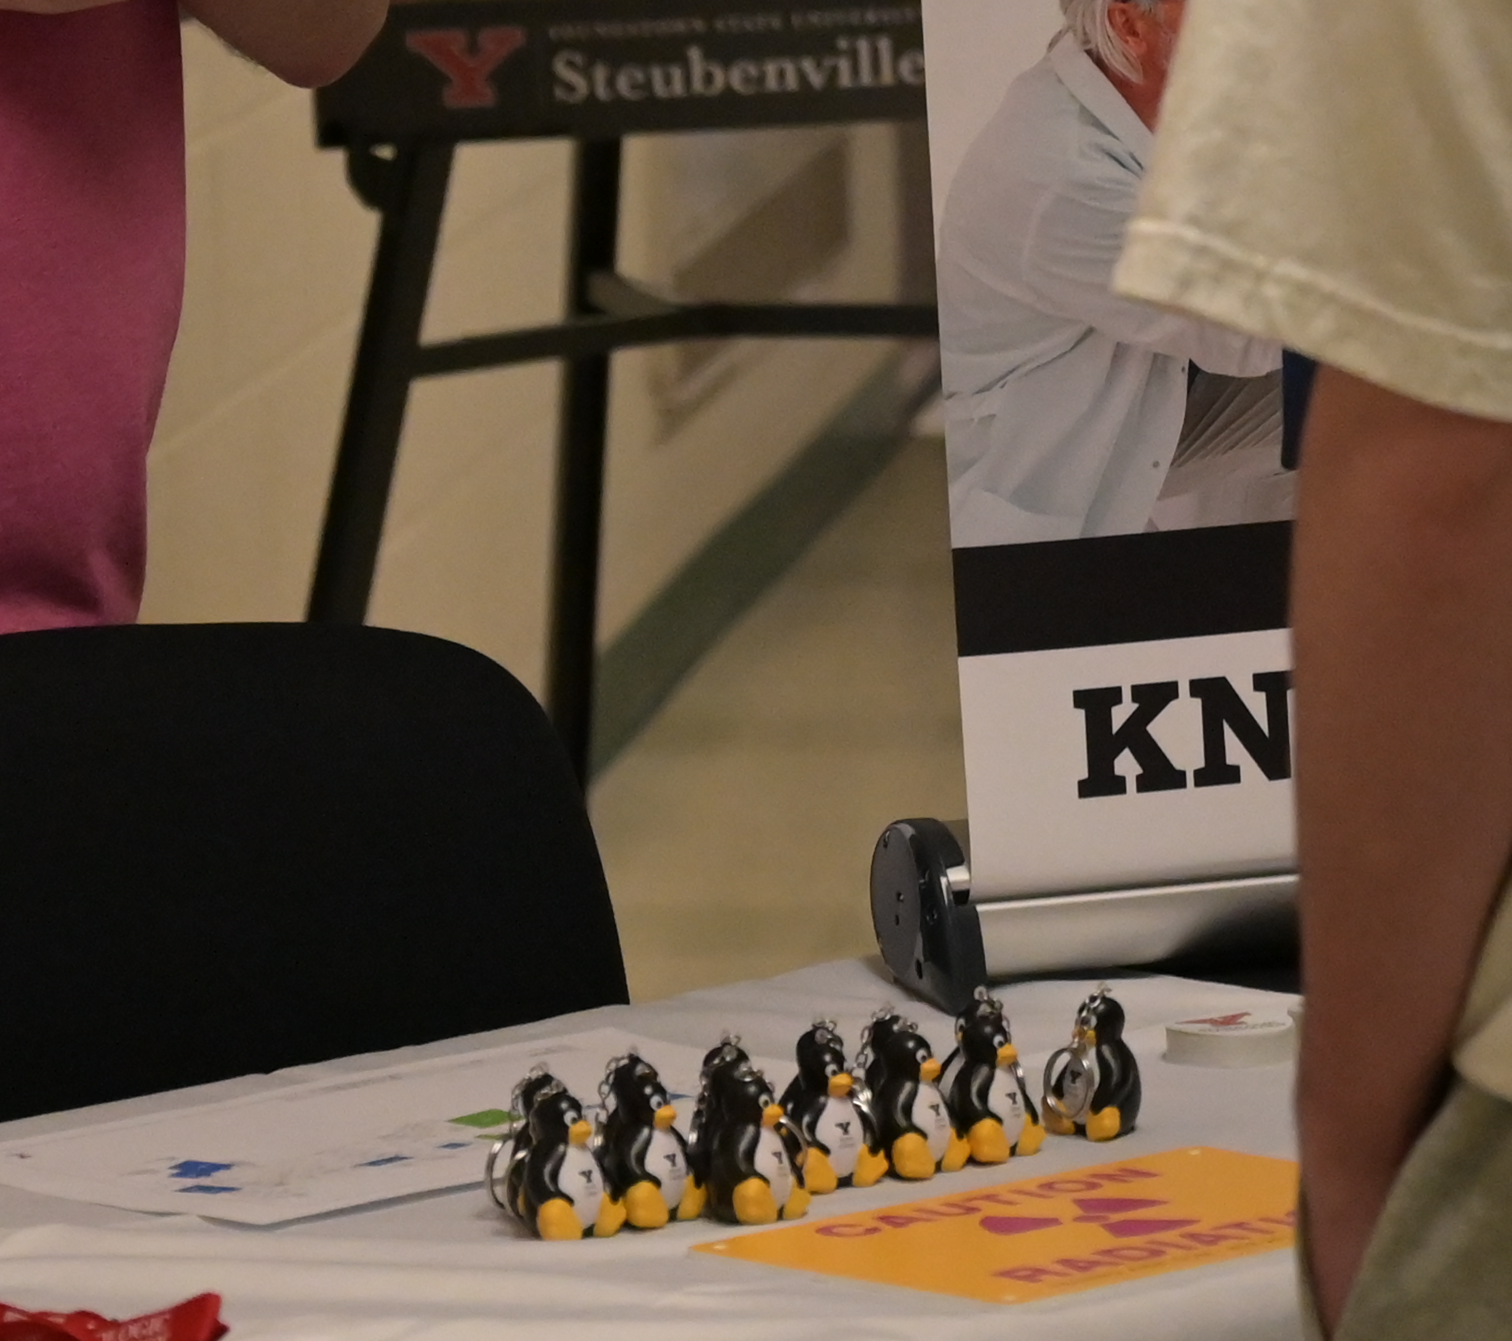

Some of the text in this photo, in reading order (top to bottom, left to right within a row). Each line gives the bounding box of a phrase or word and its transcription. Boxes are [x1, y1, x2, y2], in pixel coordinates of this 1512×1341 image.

[551, 35, 925, 104] Steubenville
[1072, 670, 1293, 799] KN
[815, 1167, 1162, 1238] CAUTION
[991, 1209, 1298, 1284] RADIATI
